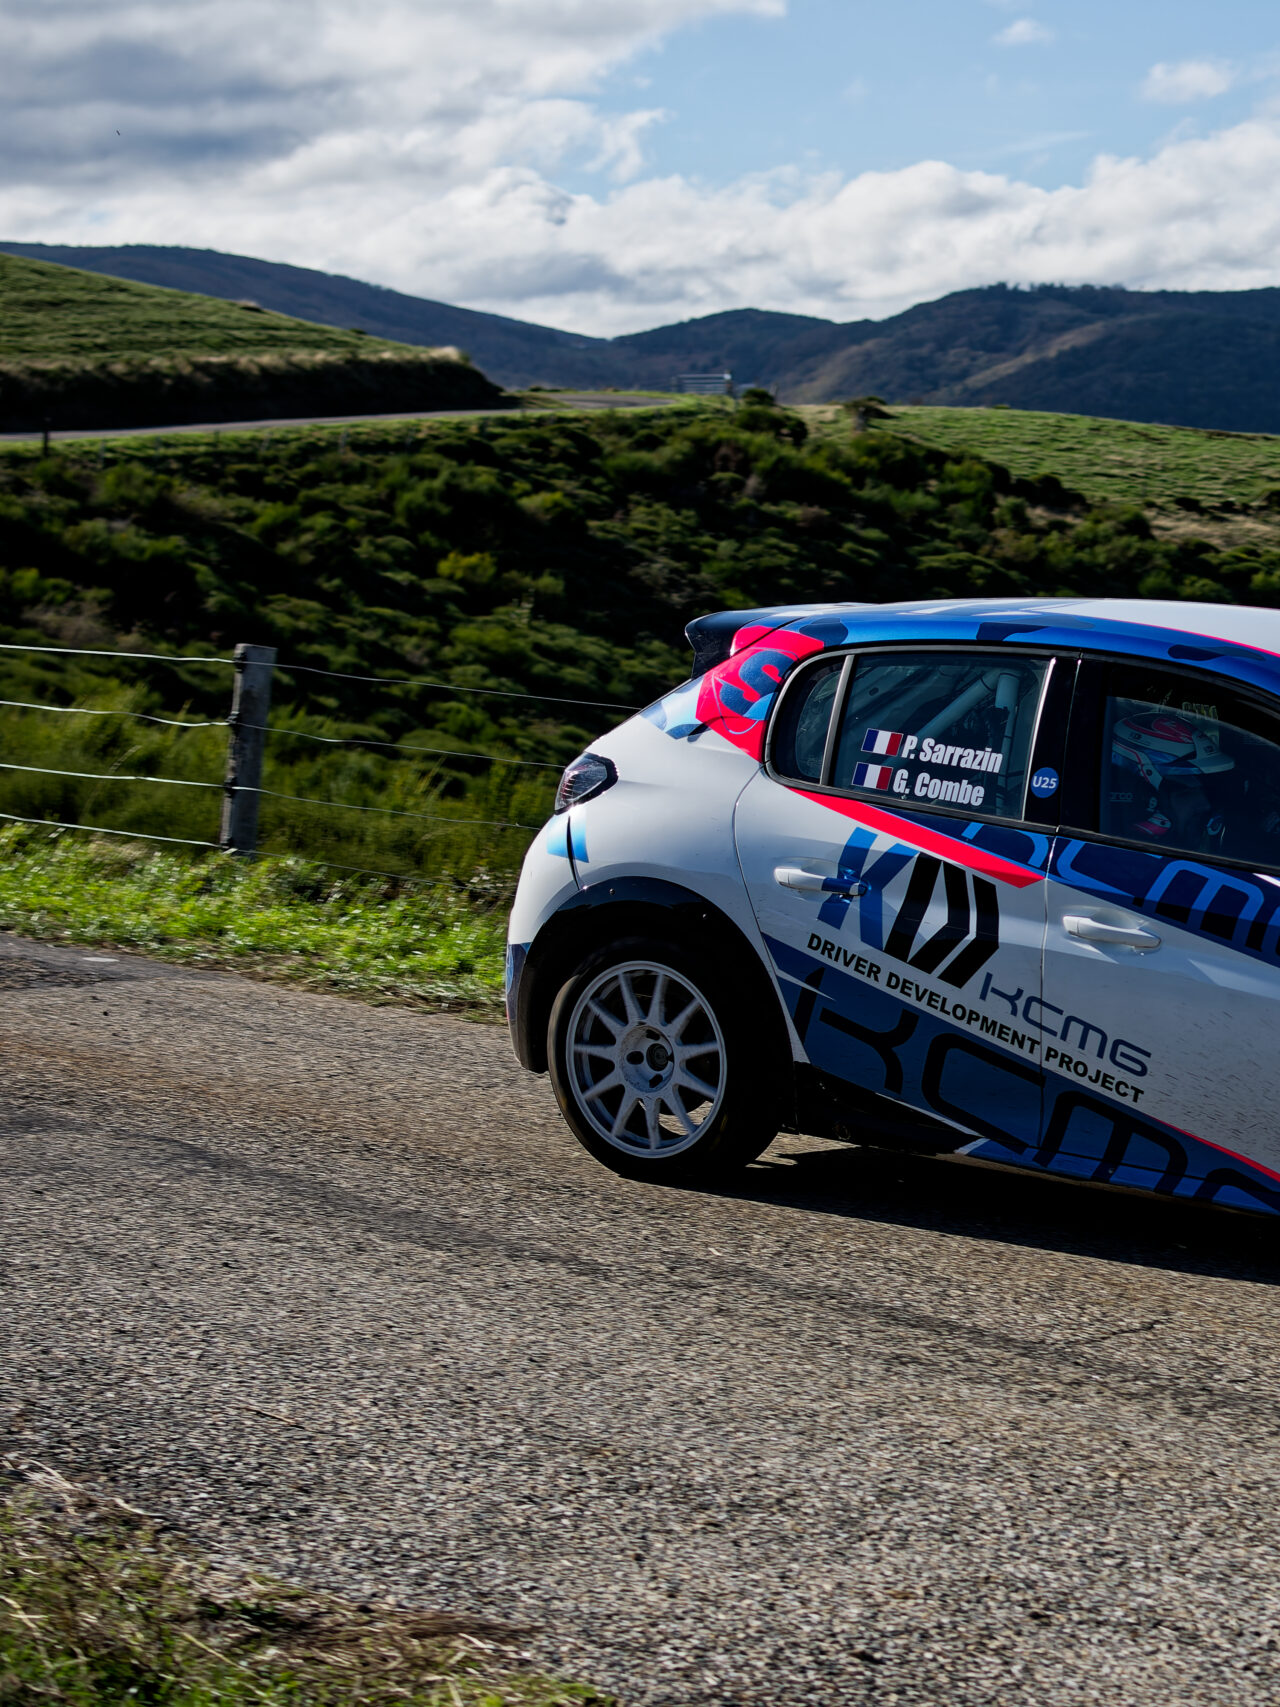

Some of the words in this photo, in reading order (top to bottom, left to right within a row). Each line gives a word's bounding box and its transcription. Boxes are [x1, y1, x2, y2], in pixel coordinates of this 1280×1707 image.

[900, 734, 917, 760] P.
[919, 737, 1003, 774] Sarrazin
[893, 770, 911, 794] G.
[914, 773, 985, 807] Combe
[1032, 775, 1058, 790] U25
[807, 933, 881, 982] DRIVER
[886, 971, 1041, 1055] DEVELOPMENT
[1044, 1047, 1146, 1103] PROJECT
[979, 972, 1152, 1077] KCMG
